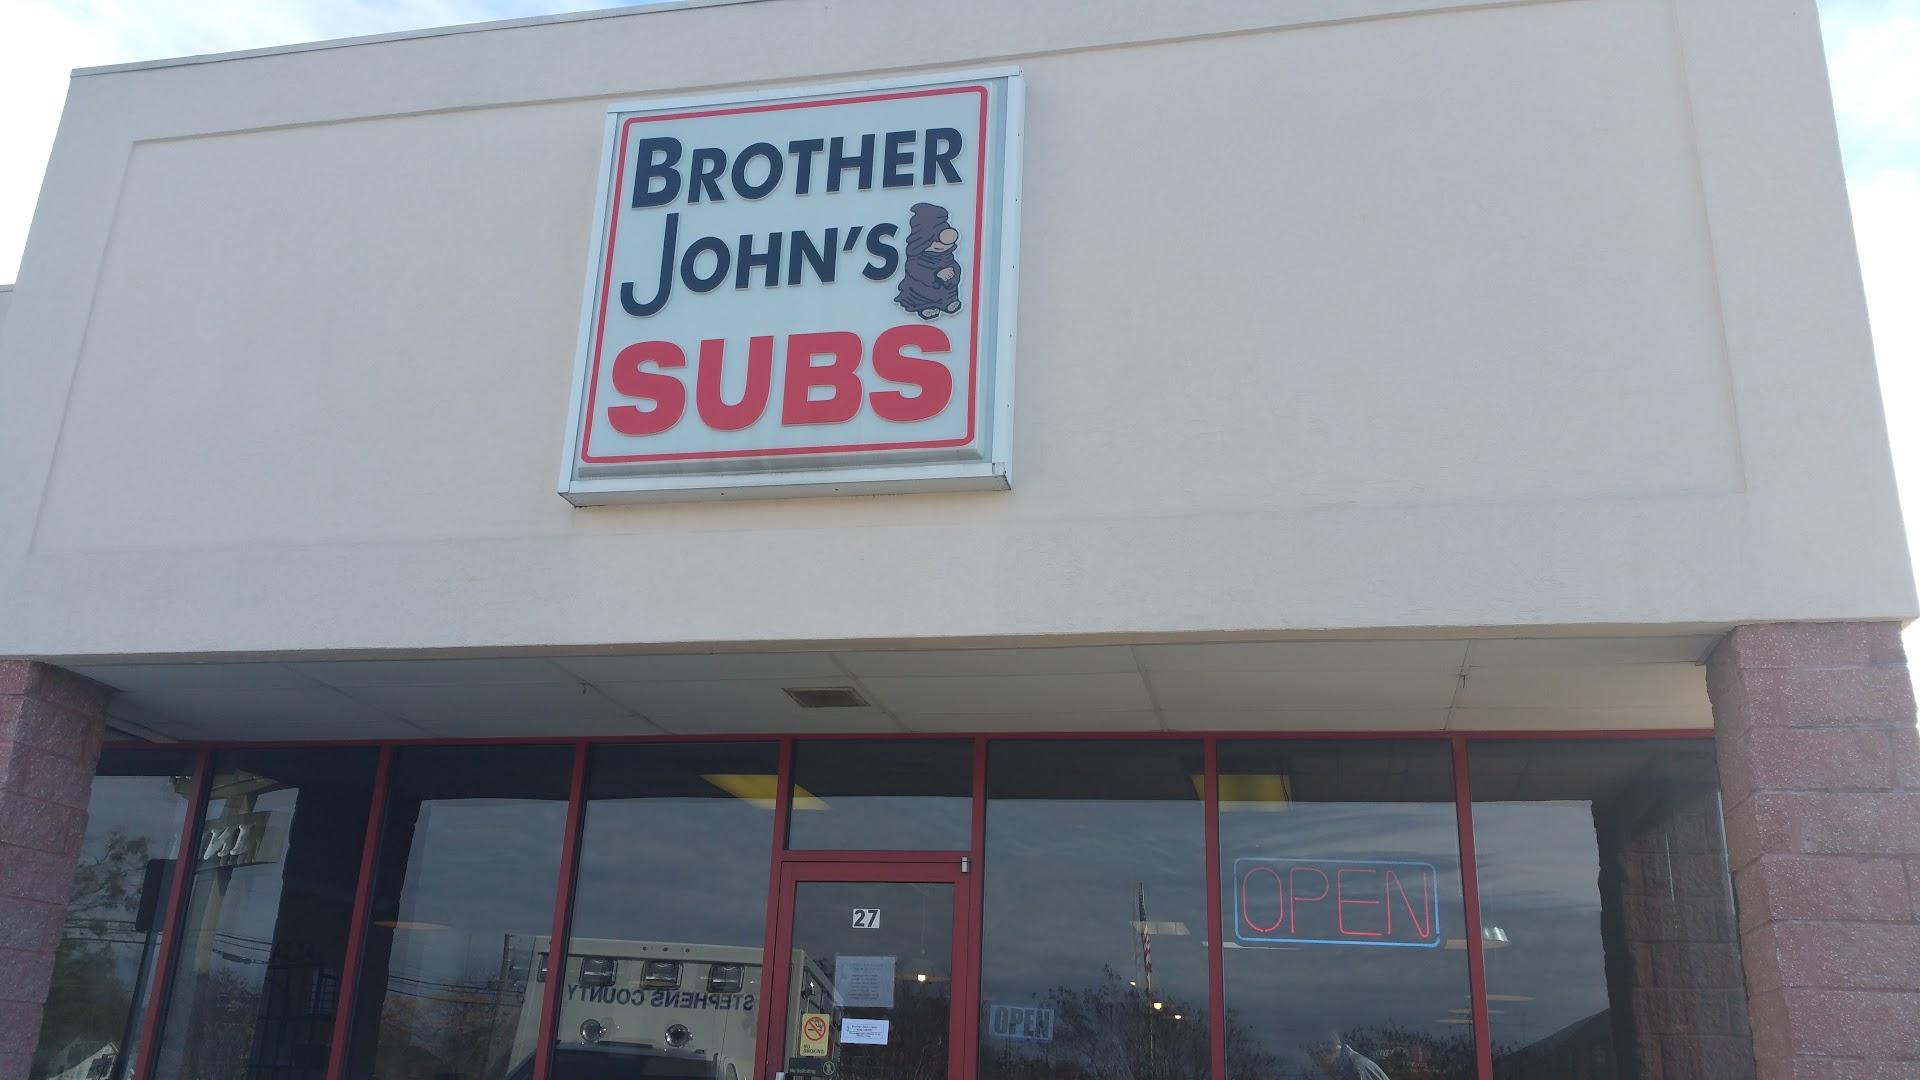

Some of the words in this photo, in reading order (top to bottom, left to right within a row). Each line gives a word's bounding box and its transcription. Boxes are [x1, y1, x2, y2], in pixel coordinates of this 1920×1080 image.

[631, 126, 964, 209] BROTHER
[620, 212, 899, 318] JOHN'S
[607, 324, 955, 438] SUBS
[853, 909, 879, 928] 27
[1242, 866, 1430, 938] OPEN
[994, 1007, 1050, 1039] OPEN
